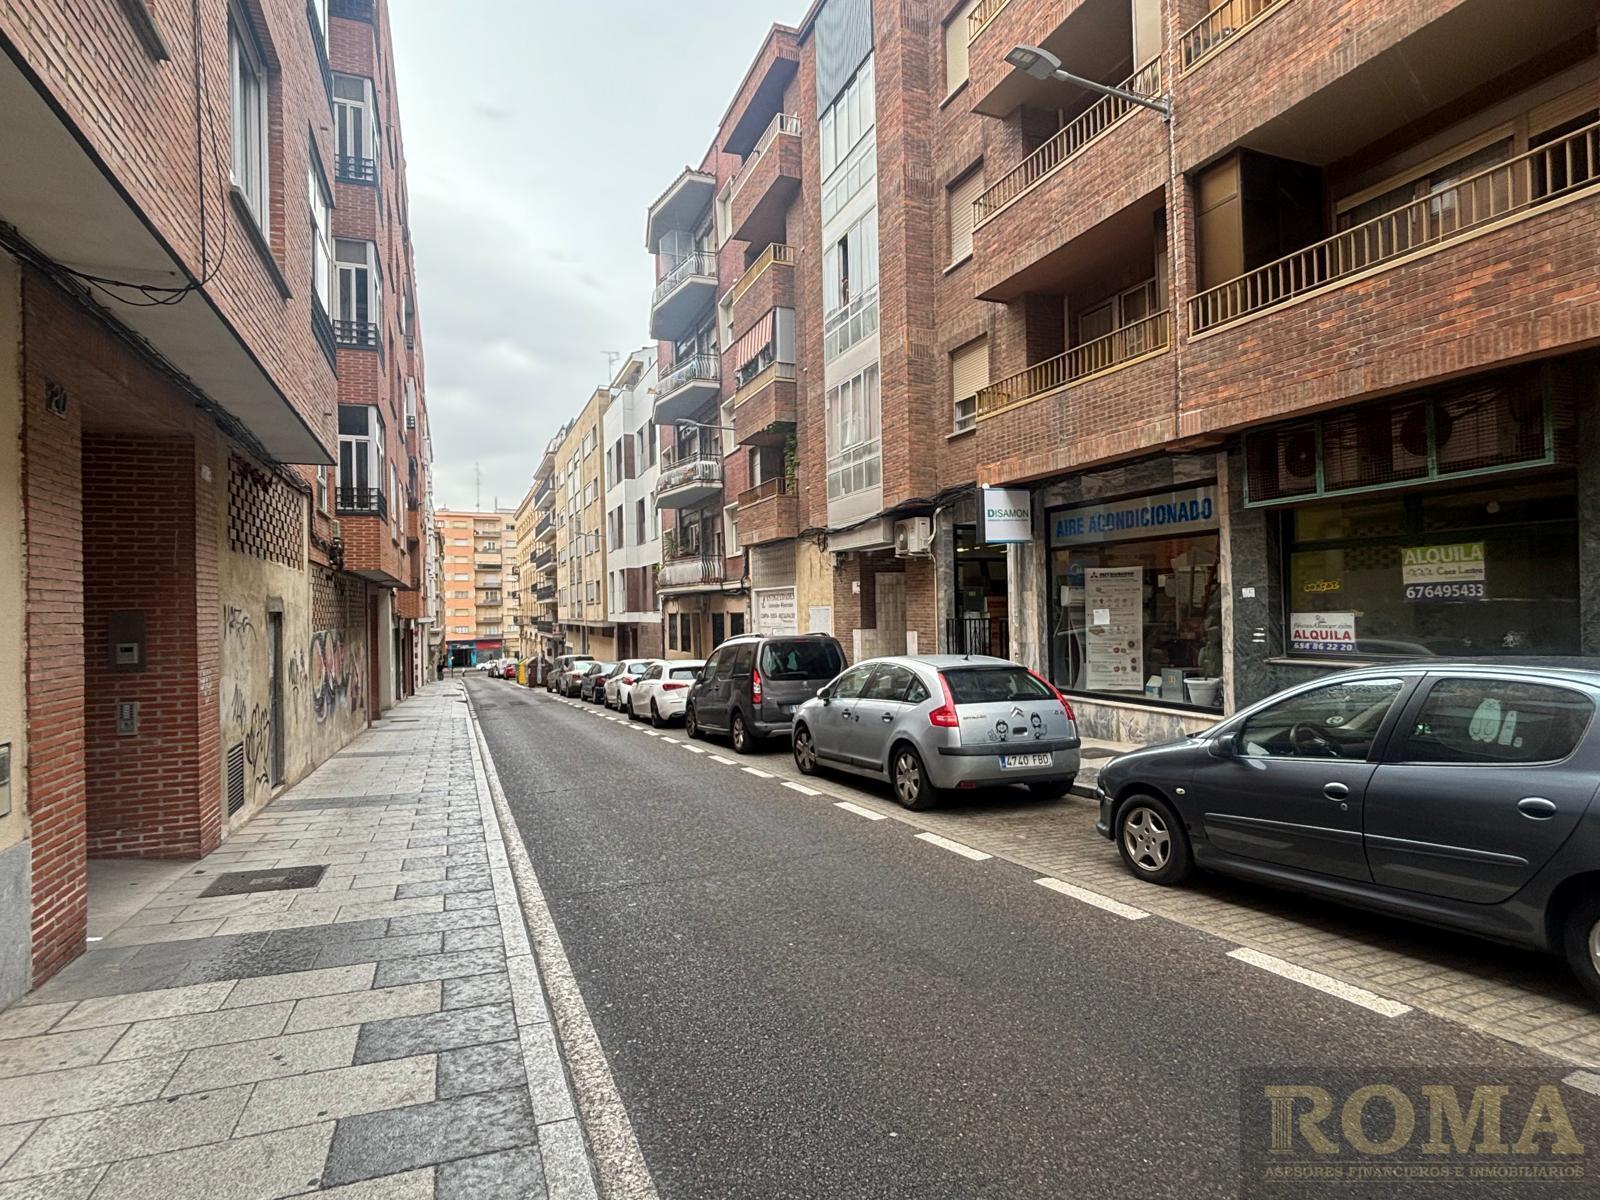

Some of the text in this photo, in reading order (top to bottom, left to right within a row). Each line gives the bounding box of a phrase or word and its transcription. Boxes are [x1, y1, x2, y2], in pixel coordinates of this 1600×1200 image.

[987, 508, 1029, 518] DISAMON
[1056, 498, 1212, 538] AIRE ACONDICIONADO
[1404, 544, 1483, 565] ALQUILA
[1406, 583, 1484, 599] 676495433
[1293, 629, 1352, 641] ALQUILA
[1326, 643, 1338, 651] 22
[1340, 644, 1353, 652] 20
[1007, 755, 1029, 767] 4740
